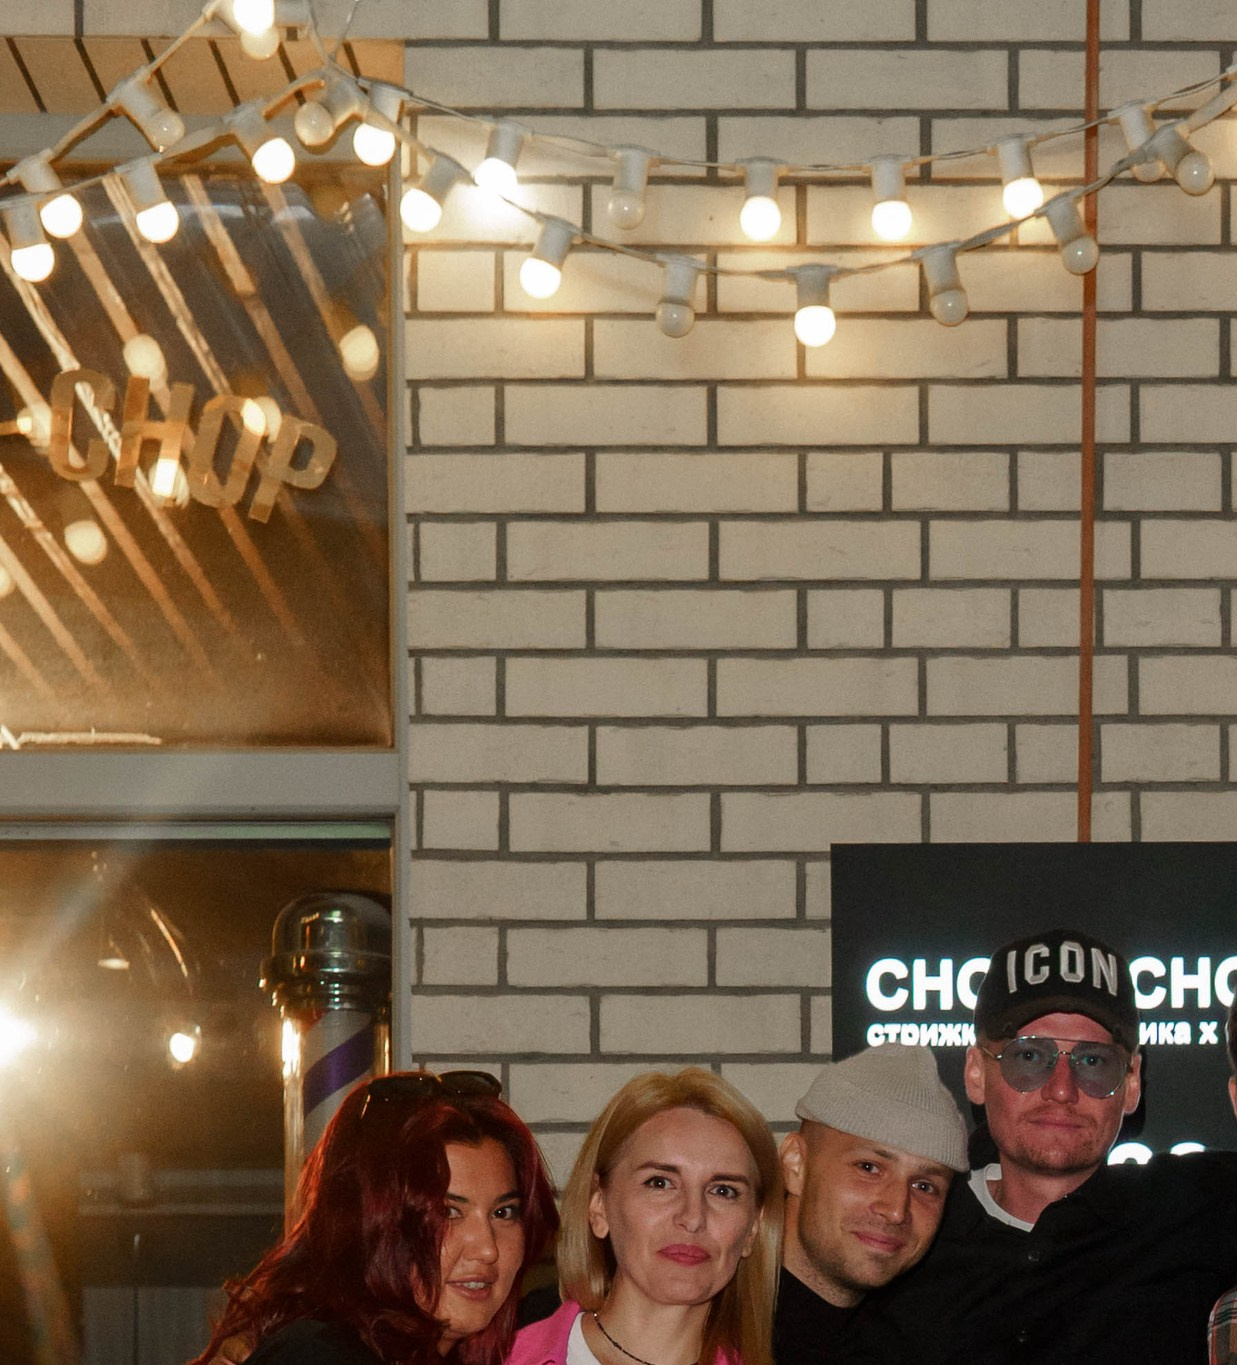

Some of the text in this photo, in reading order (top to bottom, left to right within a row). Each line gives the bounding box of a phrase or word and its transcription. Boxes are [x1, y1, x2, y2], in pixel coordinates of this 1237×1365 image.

[50, 368, 337, 524] CHOP
[865, 957, 993, 1012] CHO
[1006, 940, 1119, 997] ICON
[866, 1022, 977, 1048] стрижк
[1139, 1021, 1192, 1046] ика
